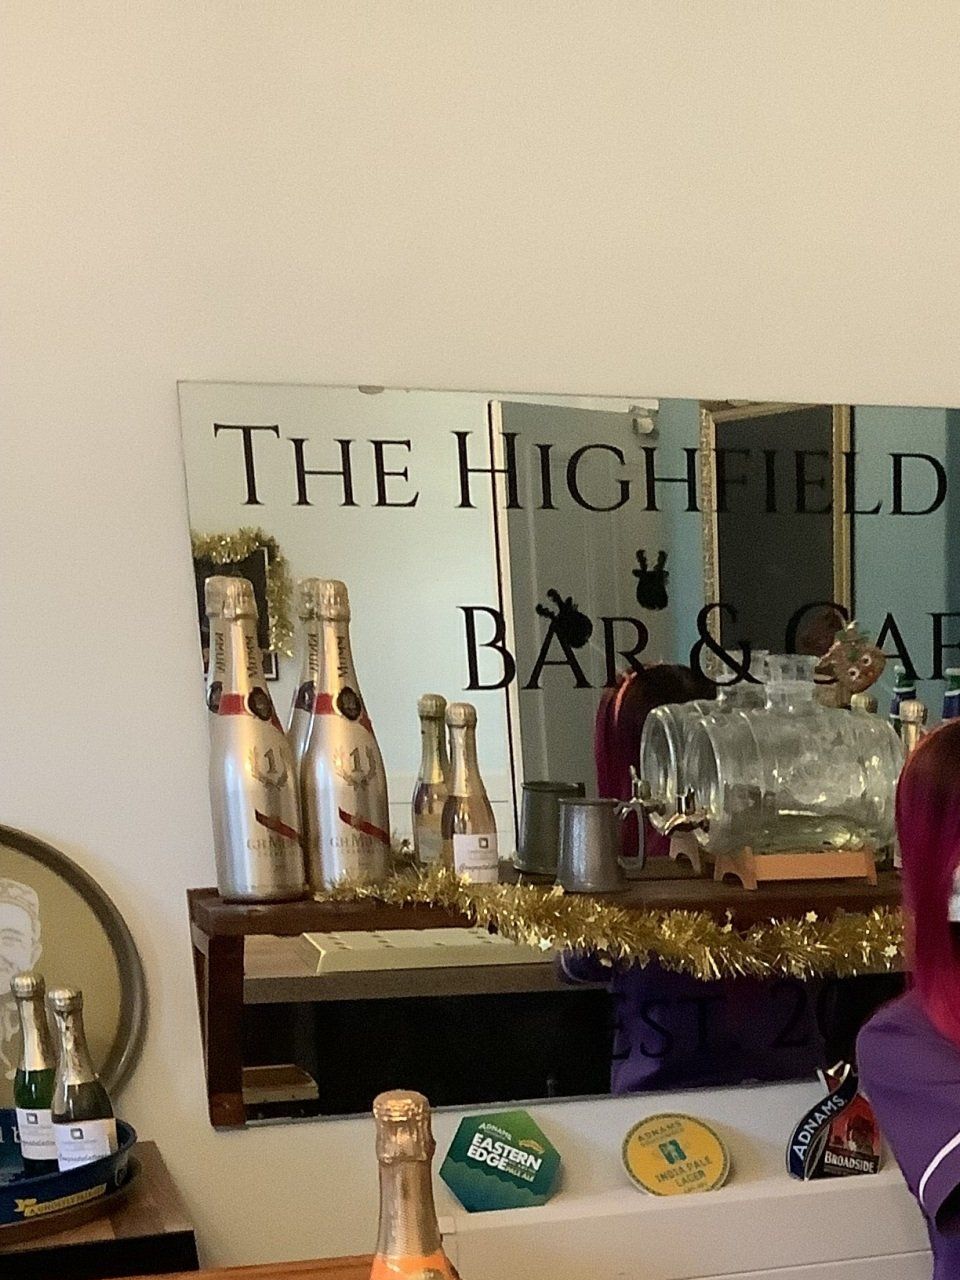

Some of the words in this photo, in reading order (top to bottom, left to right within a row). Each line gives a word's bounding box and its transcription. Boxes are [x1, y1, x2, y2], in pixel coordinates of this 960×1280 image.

[214, 422, 420, 508] THE
[451, 430, 949, 516] HIGHFIELD
[457, 604, 650, 691] BAR
[690, 602, 764, 686] &
[472, 1132, 543, 1171] EASTERN
[793, 1095, 845, 1160] ADNAMS
[467, 1144, 509, 1172] EDGE
[824, 1150, 875, 1173] BROADSIDE
